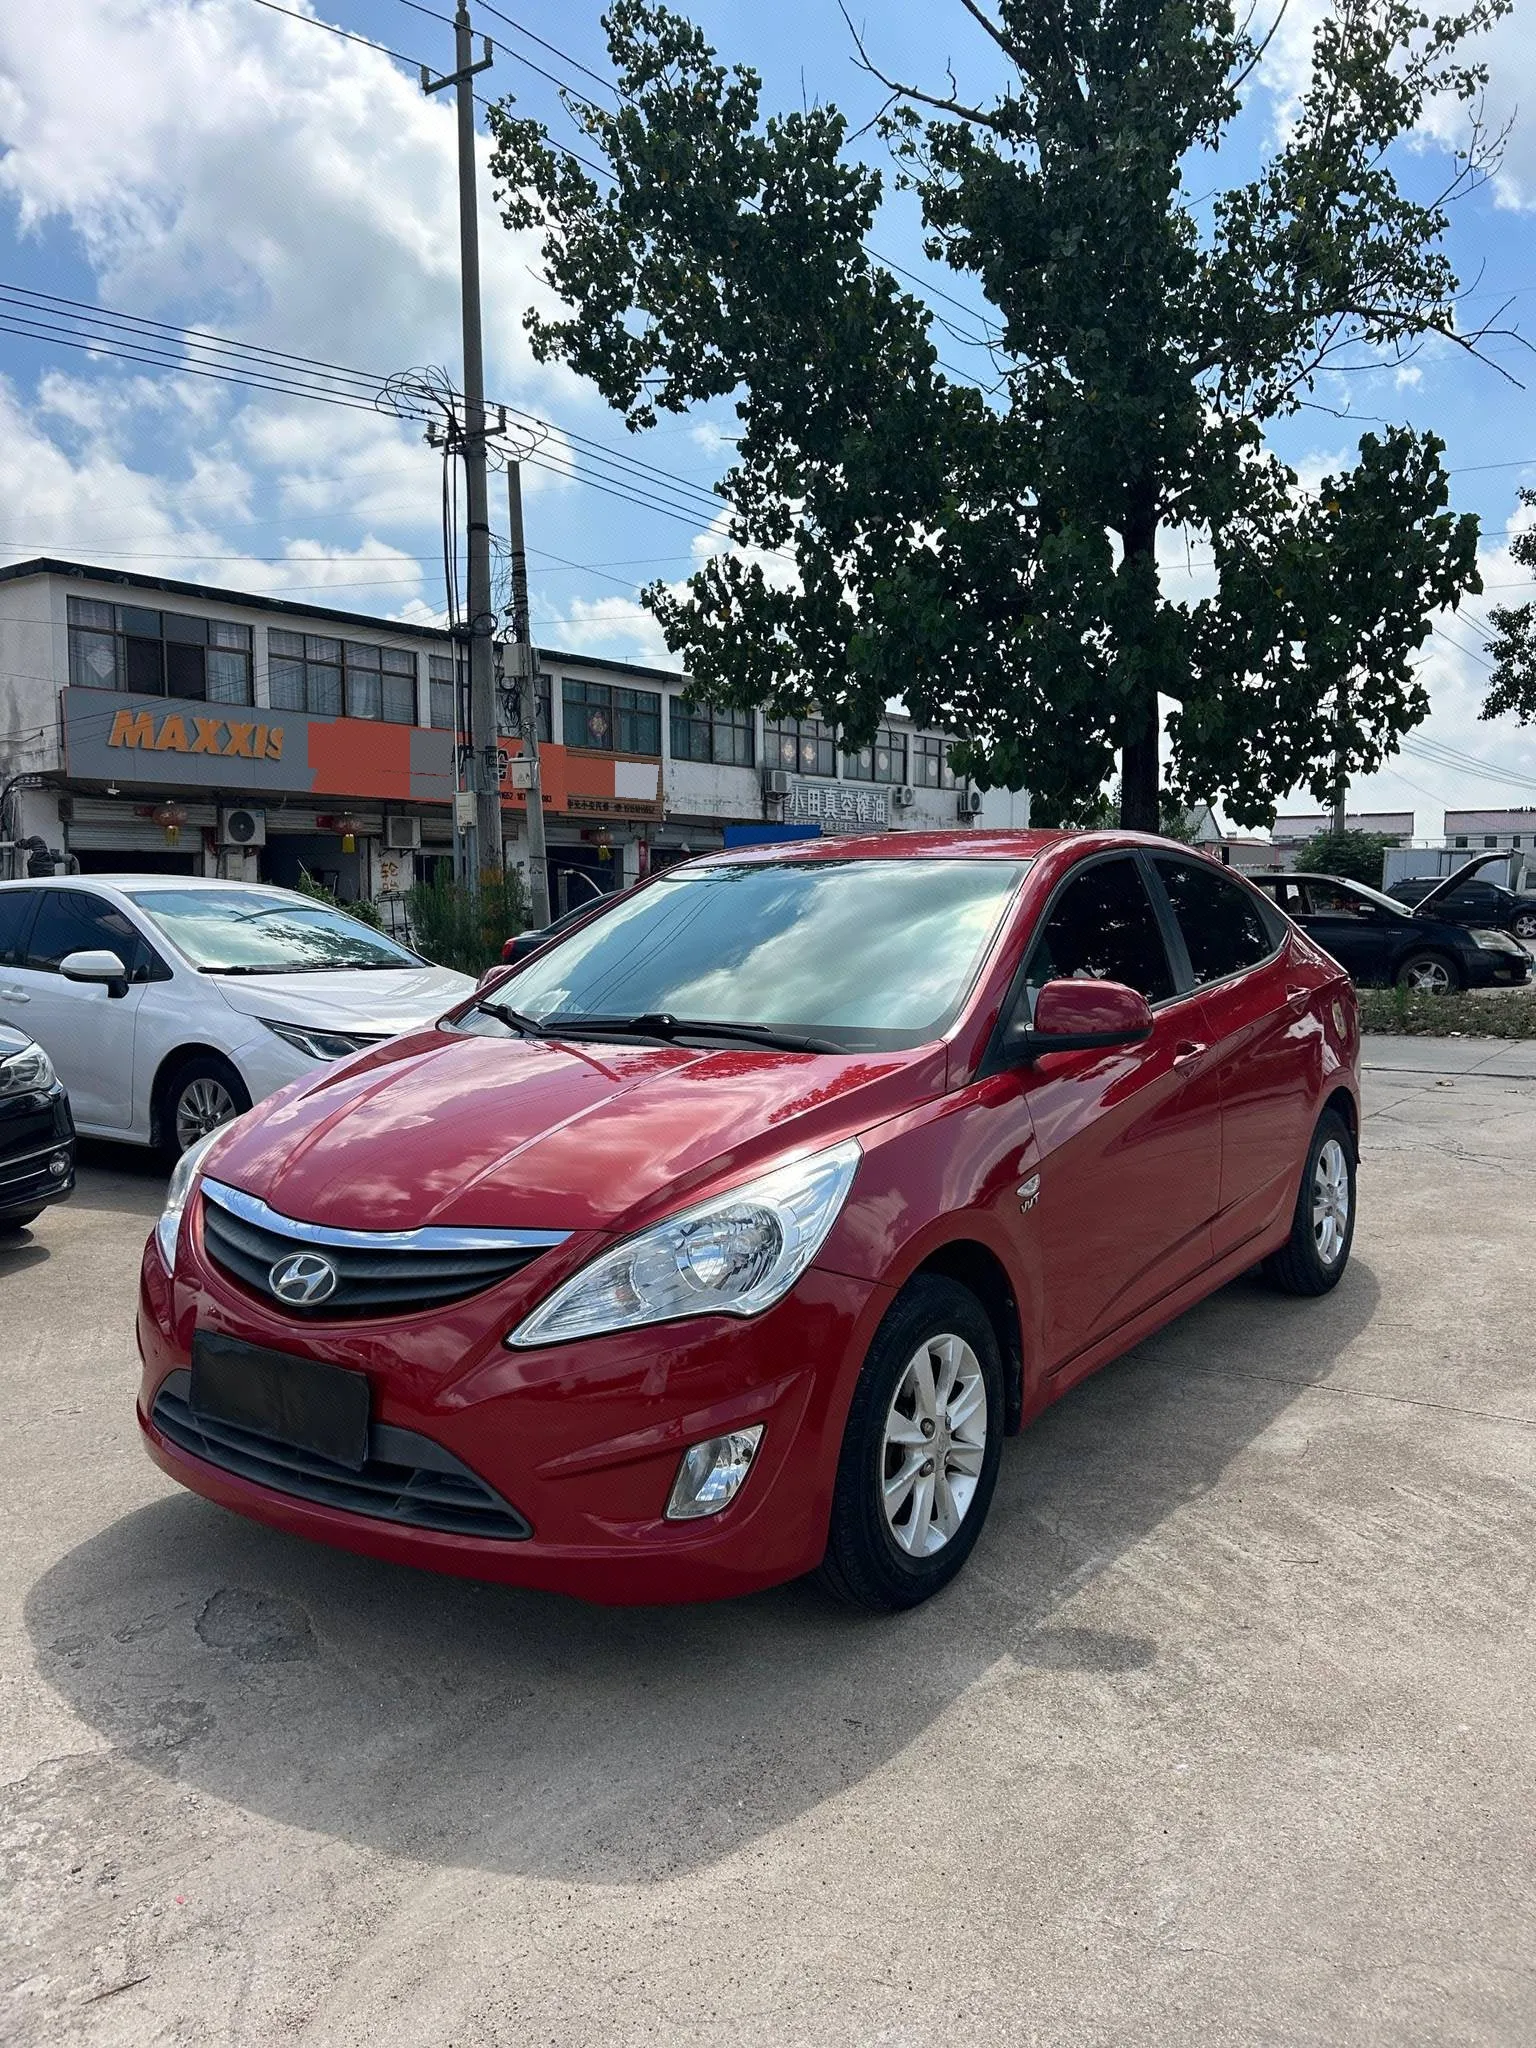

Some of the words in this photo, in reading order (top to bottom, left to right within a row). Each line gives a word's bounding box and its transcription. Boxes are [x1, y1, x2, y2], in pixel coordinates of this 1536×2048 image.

[108, 709, 285, 761] MAXXIS
[789, 785, 886, 823] 小田真空榨油
